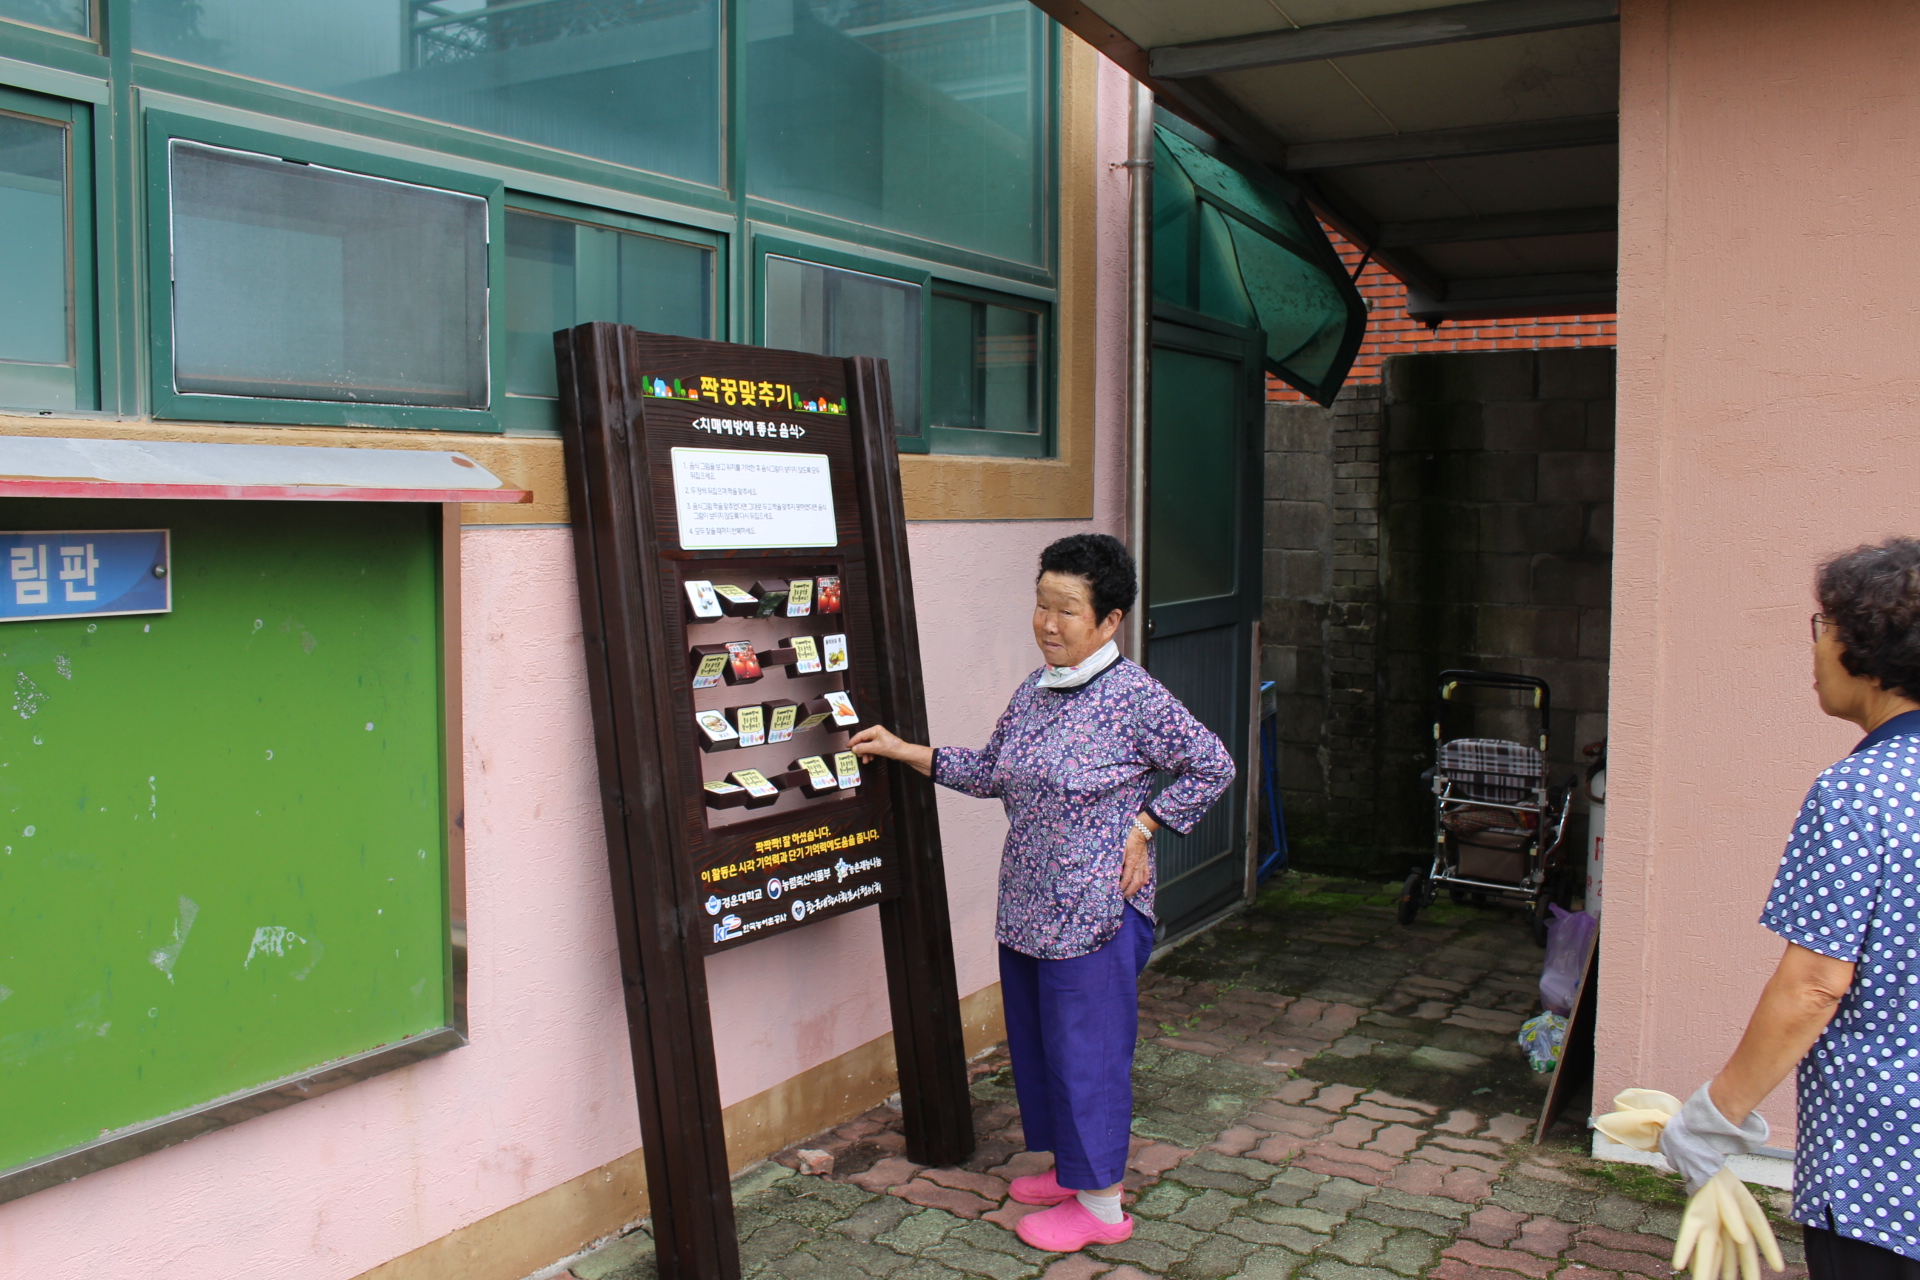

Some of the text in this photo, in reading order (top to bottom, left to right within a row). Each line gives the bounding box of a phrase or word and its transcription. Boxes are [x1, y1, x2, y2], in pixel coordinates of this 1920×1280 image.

[700, 376, 793, 409] 짝꿍맞추기
[756, 421, 777, 438] 좋은
[10, 543, 99, 604] 림판
[755, 826, 832, 854] 짝짝짝! 잘 하셨습니다.
[701, 870, 711, 883] 이
[711, 865, 738, 882] 활동은
[739, 860, 756, 874] 시각
[756, 852, 788, 870] 기억력과
[788, 847, 805, 862] 단기
[856, 829, 880, 845] 줍니다.
[781, 867, 832, 892] 농림축산식품부
[721, 888, 763, 909] 경운대학교
[742, 912, 787, 934] 한국농어촌공사
